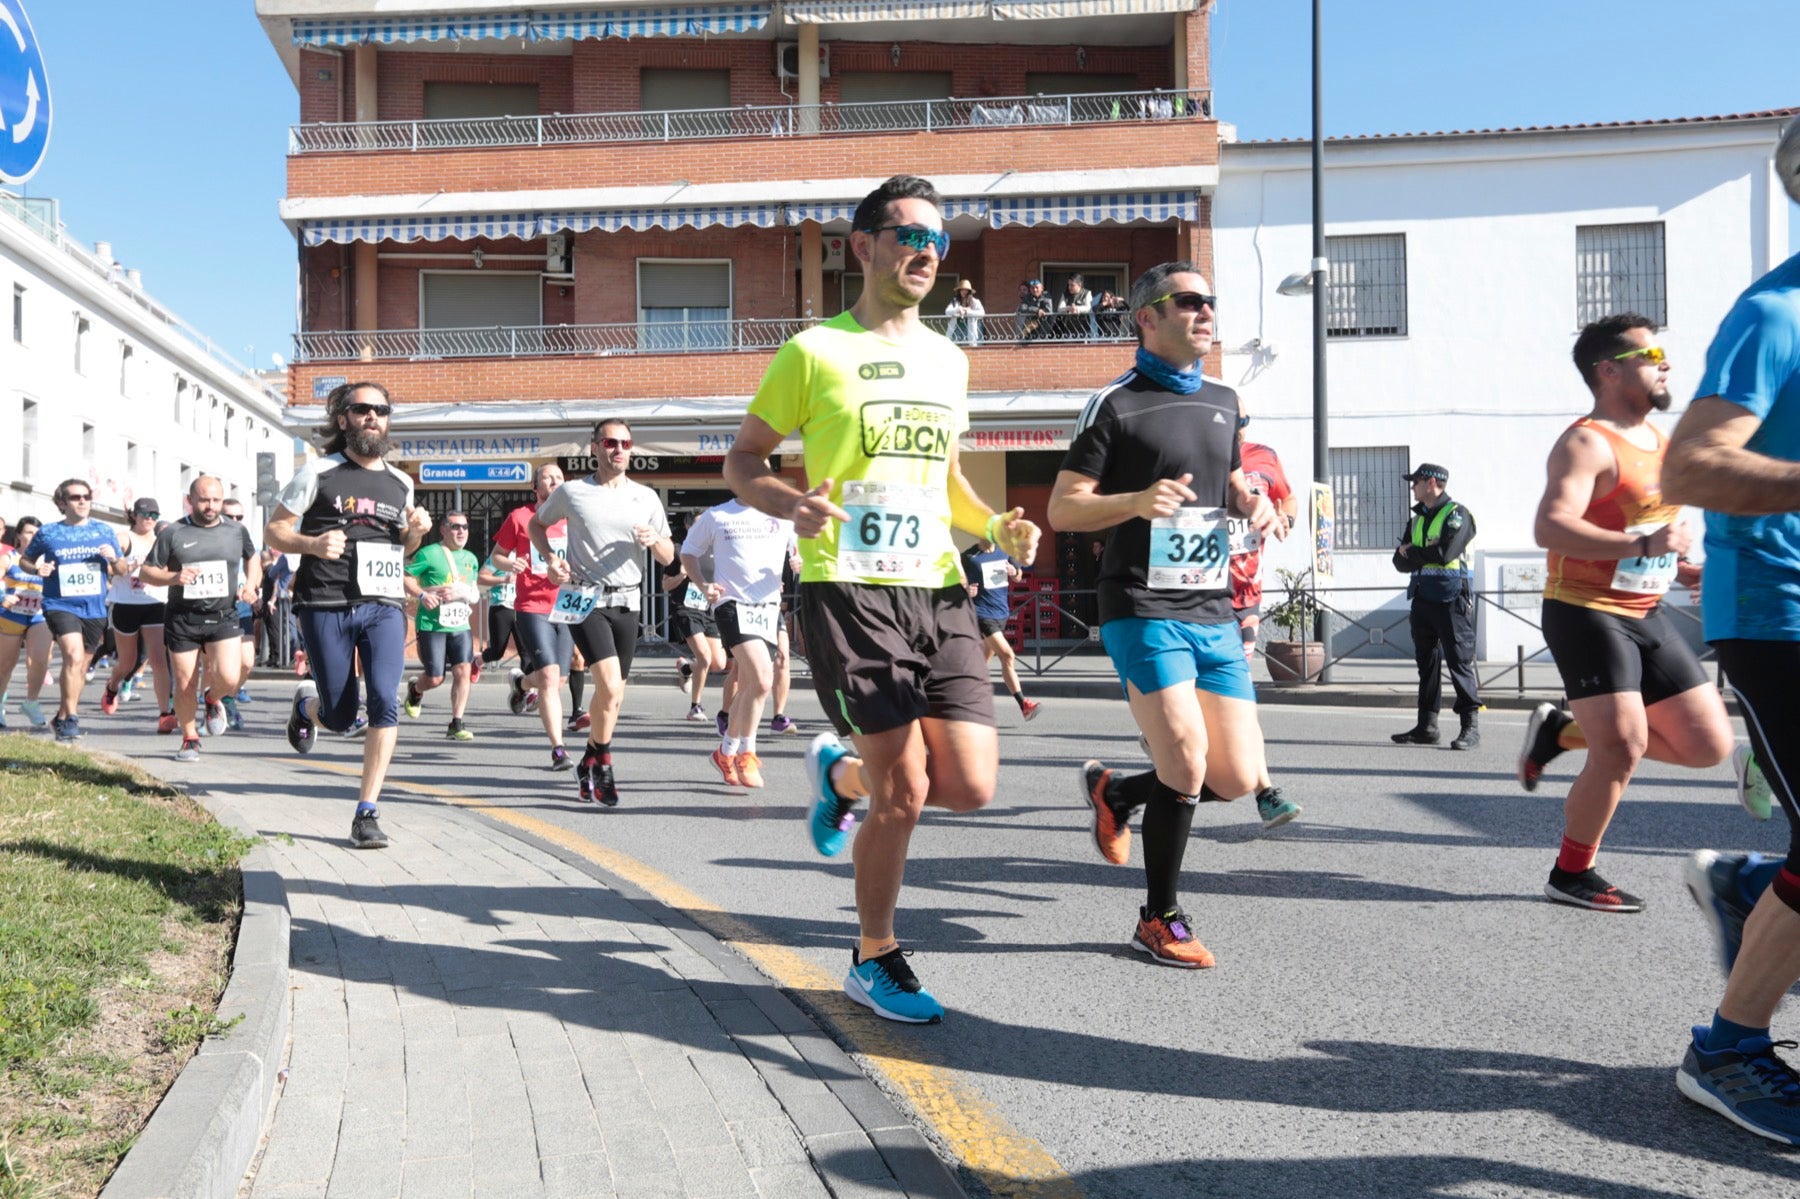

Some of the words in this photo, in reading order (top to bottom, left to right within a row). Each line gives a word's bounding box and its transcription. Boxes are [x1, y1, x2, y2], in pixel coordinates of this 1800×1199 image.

[401, 436, 541, 457] RESTAURANTE
[894, 424, 950, 455] BCN
[423, 468, 466, 478] Granada
[860, 511, 920, 549] 673
[1167, 533, 1220, 563] 326
[67, 573, 94, 585] 489
[365, 560, 401, 578] 1205
[562, 593, 593, 612] 343
[745, 611, 769, 631] 341
